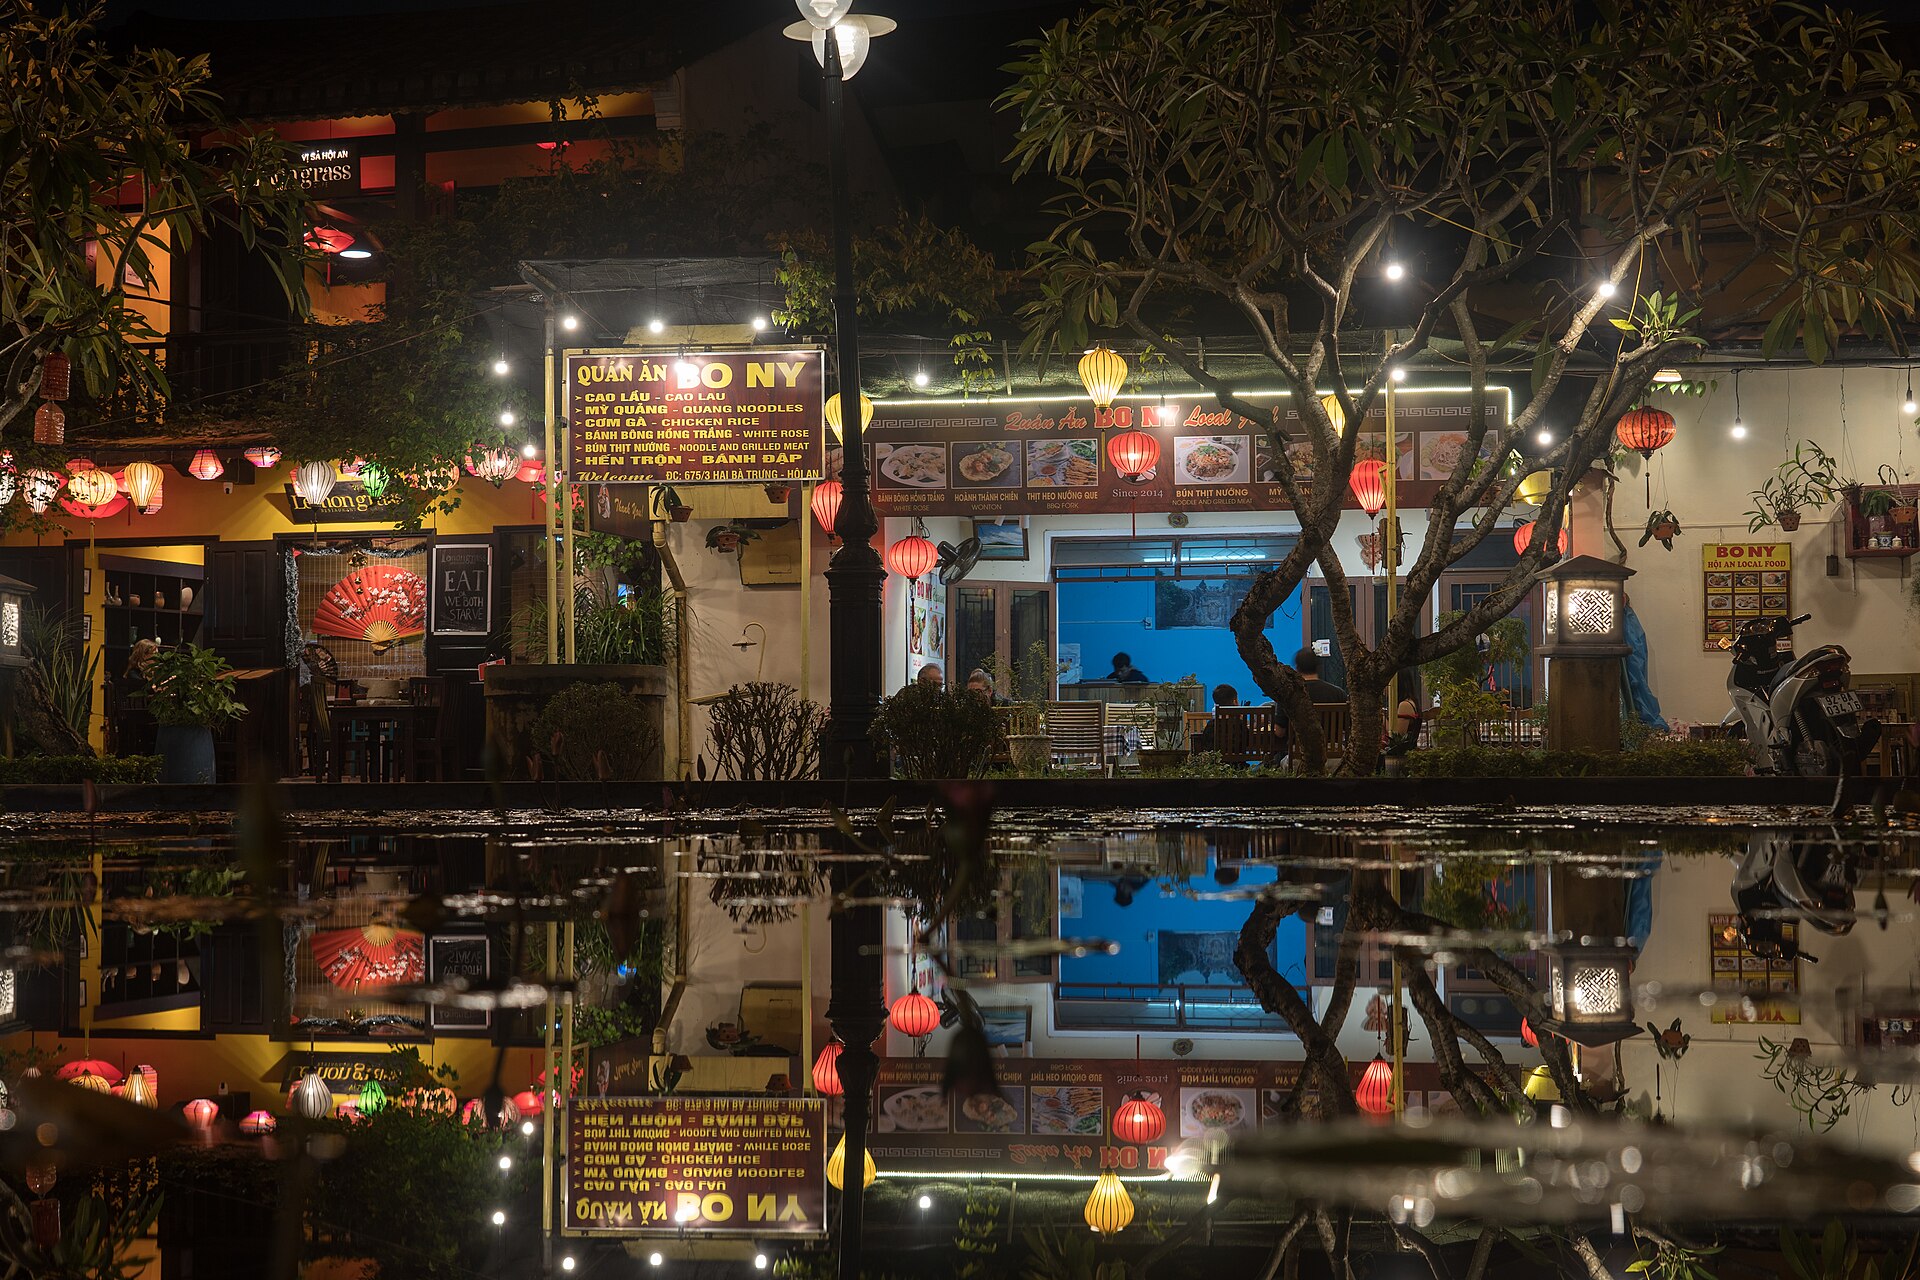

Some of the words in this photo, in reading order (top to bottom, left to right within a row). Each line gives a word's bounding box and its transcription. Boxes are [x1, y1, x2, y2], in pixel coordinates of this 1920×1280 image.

[337, 150, 349, 158] AN
[577, 360, 634, 386] QUÁN
[638, 359, 668, 382] ĂN
[677, 362, 733, 389] BO
[746, 361, 806, 388] NY
[584, 393, 616, 402] CAO
[665, 392, 694, 402] CAO
[698, 392, 726, 401] LAU
[613, 402, 668, 415] QUẢNG
[682, 405, 732, 414] QUANG
[737, 404, 804, 413] NOODLES
[585, 418, 621, 427] CƠM
[625, 416, 647, 427] GÀ
[661, 418, 723, 427] CHICKEN
[727, 417, 760, 426] RICE
[1004, 411, 1054, 431] Quán
[1058, 407, 1087, 430] Ăn
[1094, 406, 1132, 429] BO
[1141, 405, 1180, 428] NY
[1184, 405, 1231, 427] Local
[585, 430, 618, 440] BÁNH
[621, 429, 654, 440] BÔNG
[743, 430, 778, 438] WHITE
[780, 429, 809, 438] ROSE
[585, 442, 607, 453] BÚN
[609, 443, 631, 454] THỊT
[679, 443, 717, 452] NOODLE
[719, 443, 739, 451] AND
[741, 443, 781, 451] GRILLED
[783, 442, 810, 450] MEAT
[585, 454, 625, 465] HẾN
[629, 453, 682, 466] TRỘN
[702, 453, 756, 464] BÁNH
[762, 453, 803, 465] ĐẬP
[575, 471, 654, 481] Welcome
[684, 470, 711, 481] 675/3
[713, 470, 729, 480] HAI
[731, 468, 744, 480] BÀ
[746, 469, 778, 479] TRƯNG
[806, 469, 819, 479] AN
[1027, 492, 1040, 502] THỊT
[1042, 492, 1056, 500] HEO
[1084, 491, 1098, 500] QUE
[1112, 489, 1138, 498] Since
[1140, 490, 1163, 498] 2014
[1176, 488, 1193, 497] BÚN
[1196, 489, 1214, 498] THỊT
[1716, 546, 1744, 558] BO
[1748, 546, 1776, 558] NY
[1708, 560, 1722, 570] HỘI
[1765, 560, 1786, 568] FOOD
[444, 569, 485, 592] EAT
[445, 596, 461, 607] WE
[463, 596, 484, 607] BOTH
[450, 608, 483, 620] STARVE
